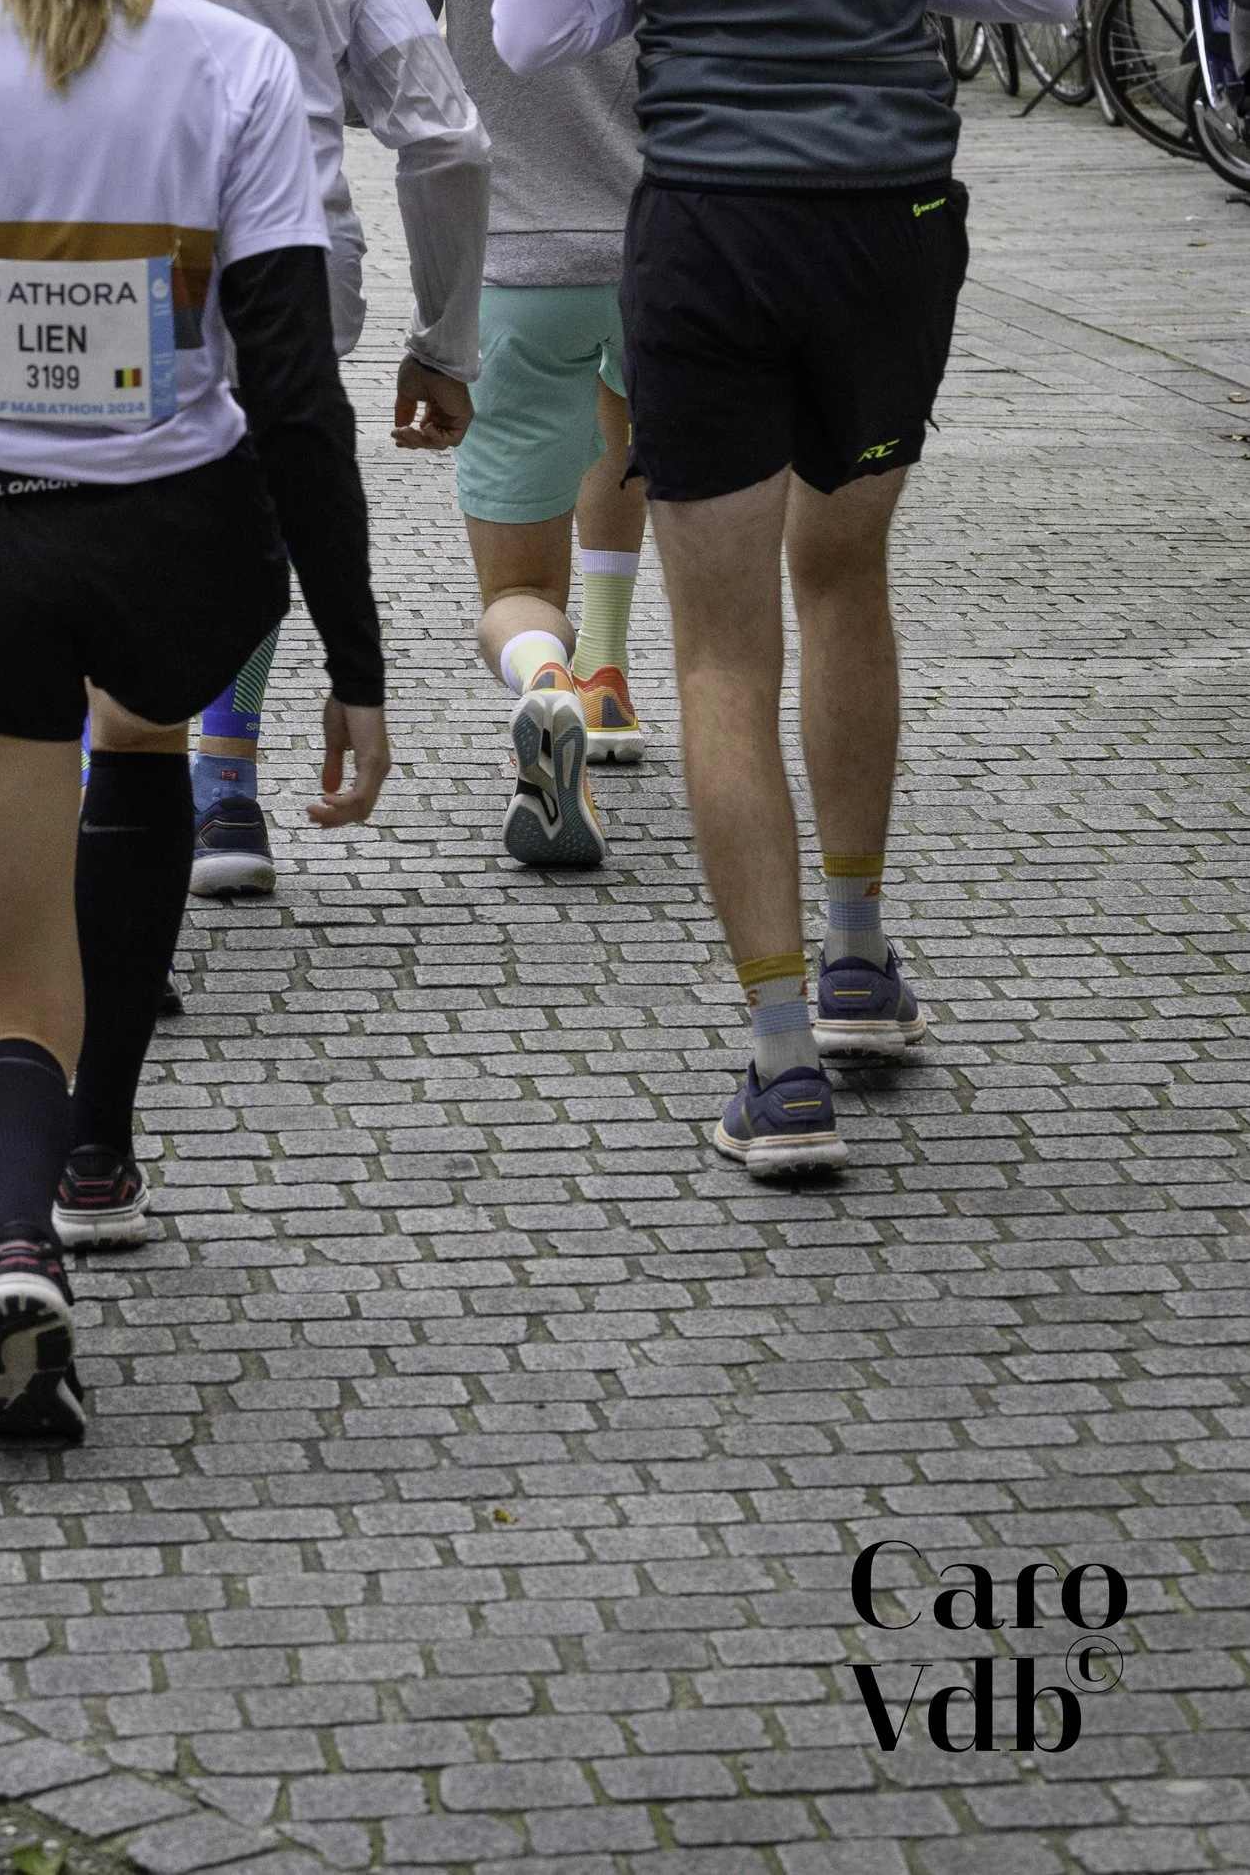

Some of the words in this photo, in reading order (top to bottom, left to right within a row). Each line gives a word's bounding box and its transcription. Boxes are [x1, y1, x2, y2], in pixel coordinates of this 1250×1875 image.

[7, 282, 138, 306] ATHORA
[18, 324, 87, 354] LIEN
[26, 364, 81, 390] 3199
[10, 399, 102, 415] MARATHON
